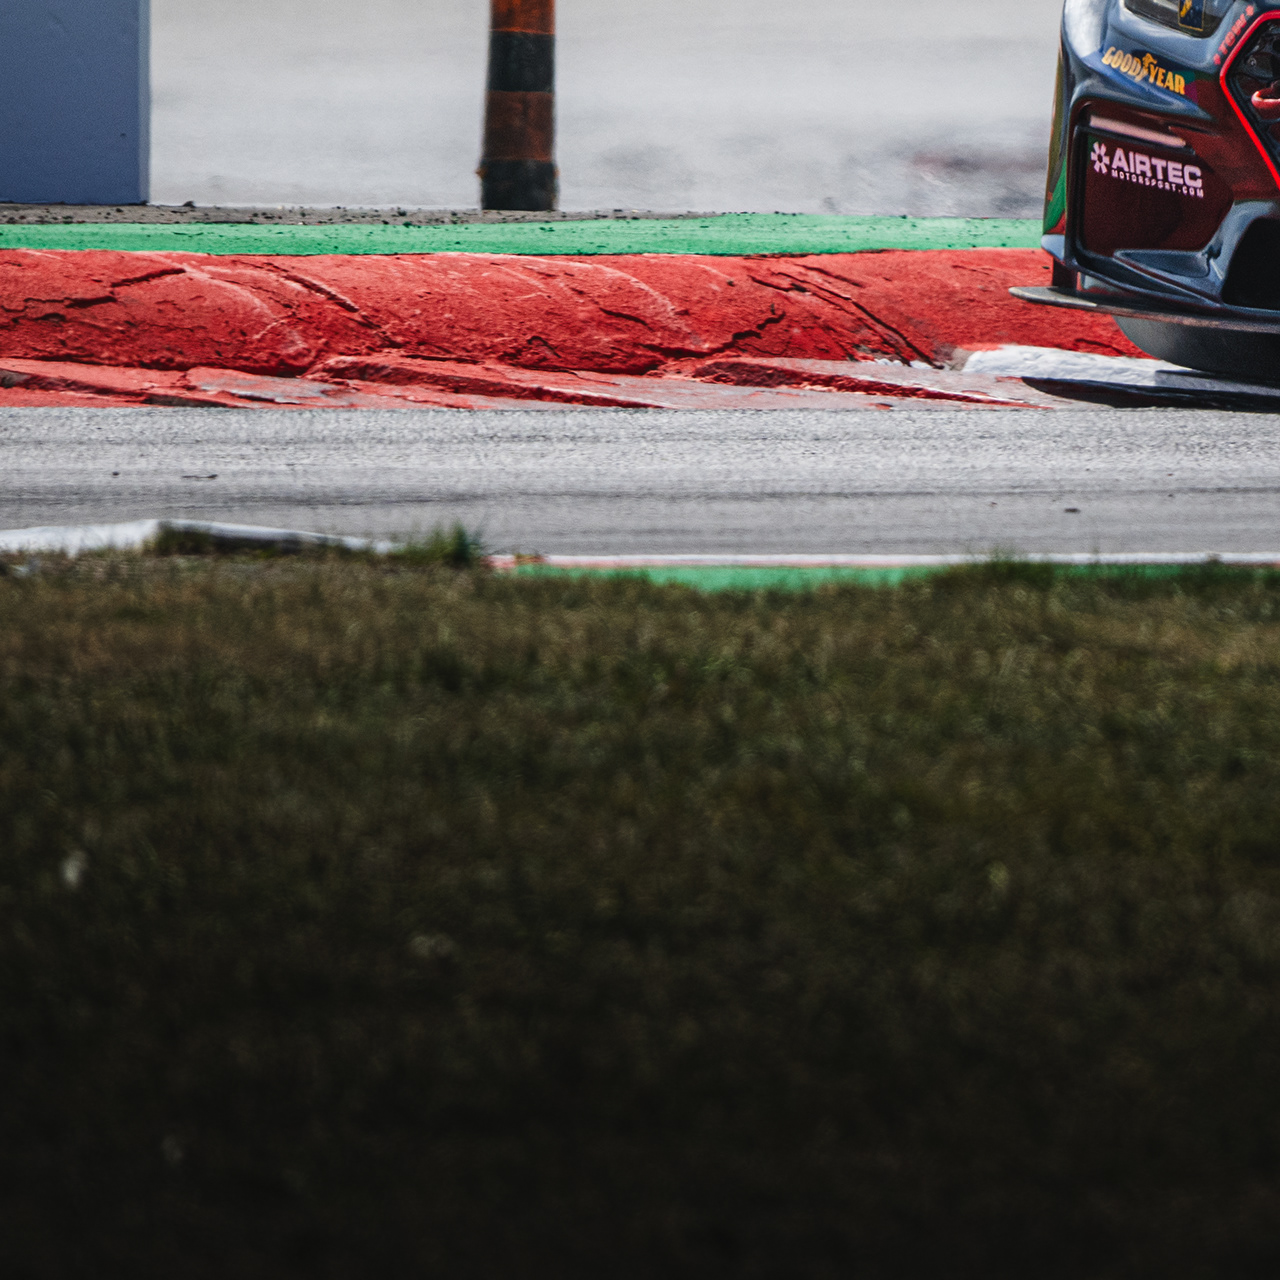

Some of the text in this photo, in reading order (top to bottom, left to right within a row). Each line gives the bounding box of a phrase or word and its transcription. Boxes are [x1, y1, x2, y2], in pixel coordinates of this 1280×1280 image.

[1101, 46, 1186, 96] GOODYEAR
[1111, 147, 1204, 188] AIRTEC
[1111, 170, 1205, 199] MOTORSPORT.COM
